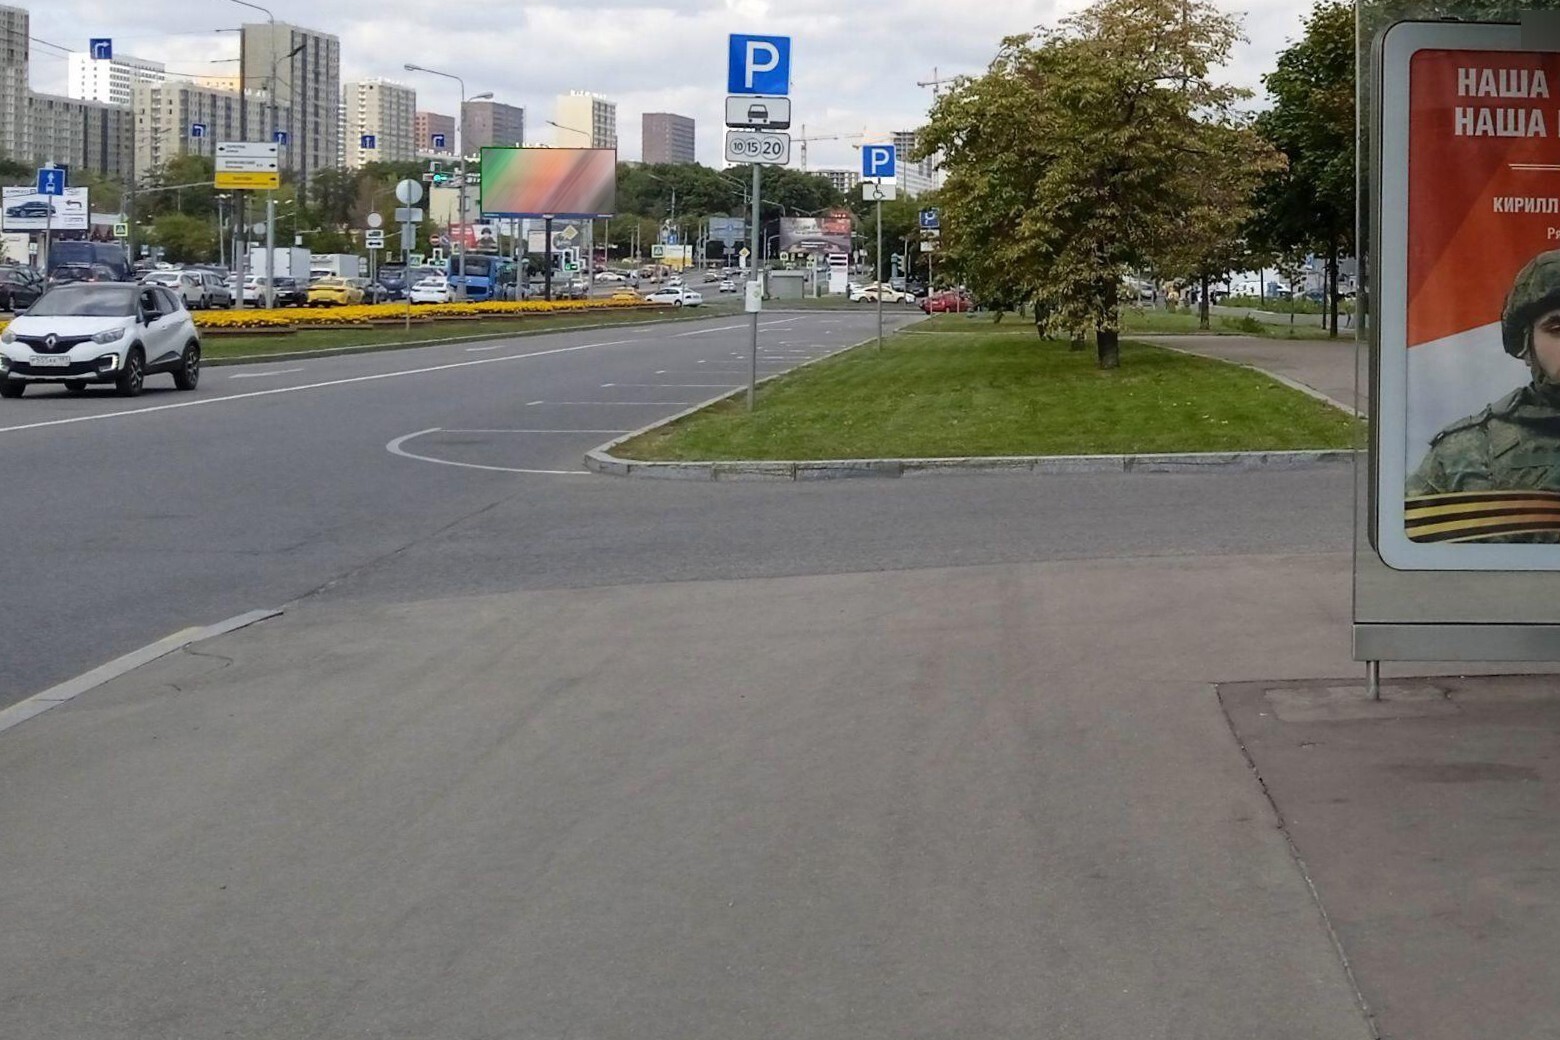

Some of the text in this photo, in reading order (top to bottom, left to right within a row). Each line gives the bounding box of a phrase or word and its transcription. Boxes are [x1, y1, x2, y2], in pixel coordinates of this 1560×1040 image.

[744, 40, 780, 88] P
[1456, 67, 1550, 99] НАША
[1453, 106, 1548, 138] НАША
[733, 141, 781, 155] 10 15 20
[871, 148, 890, 174] P
[1493, 196, 1559, 214] КИРИЛЛ
